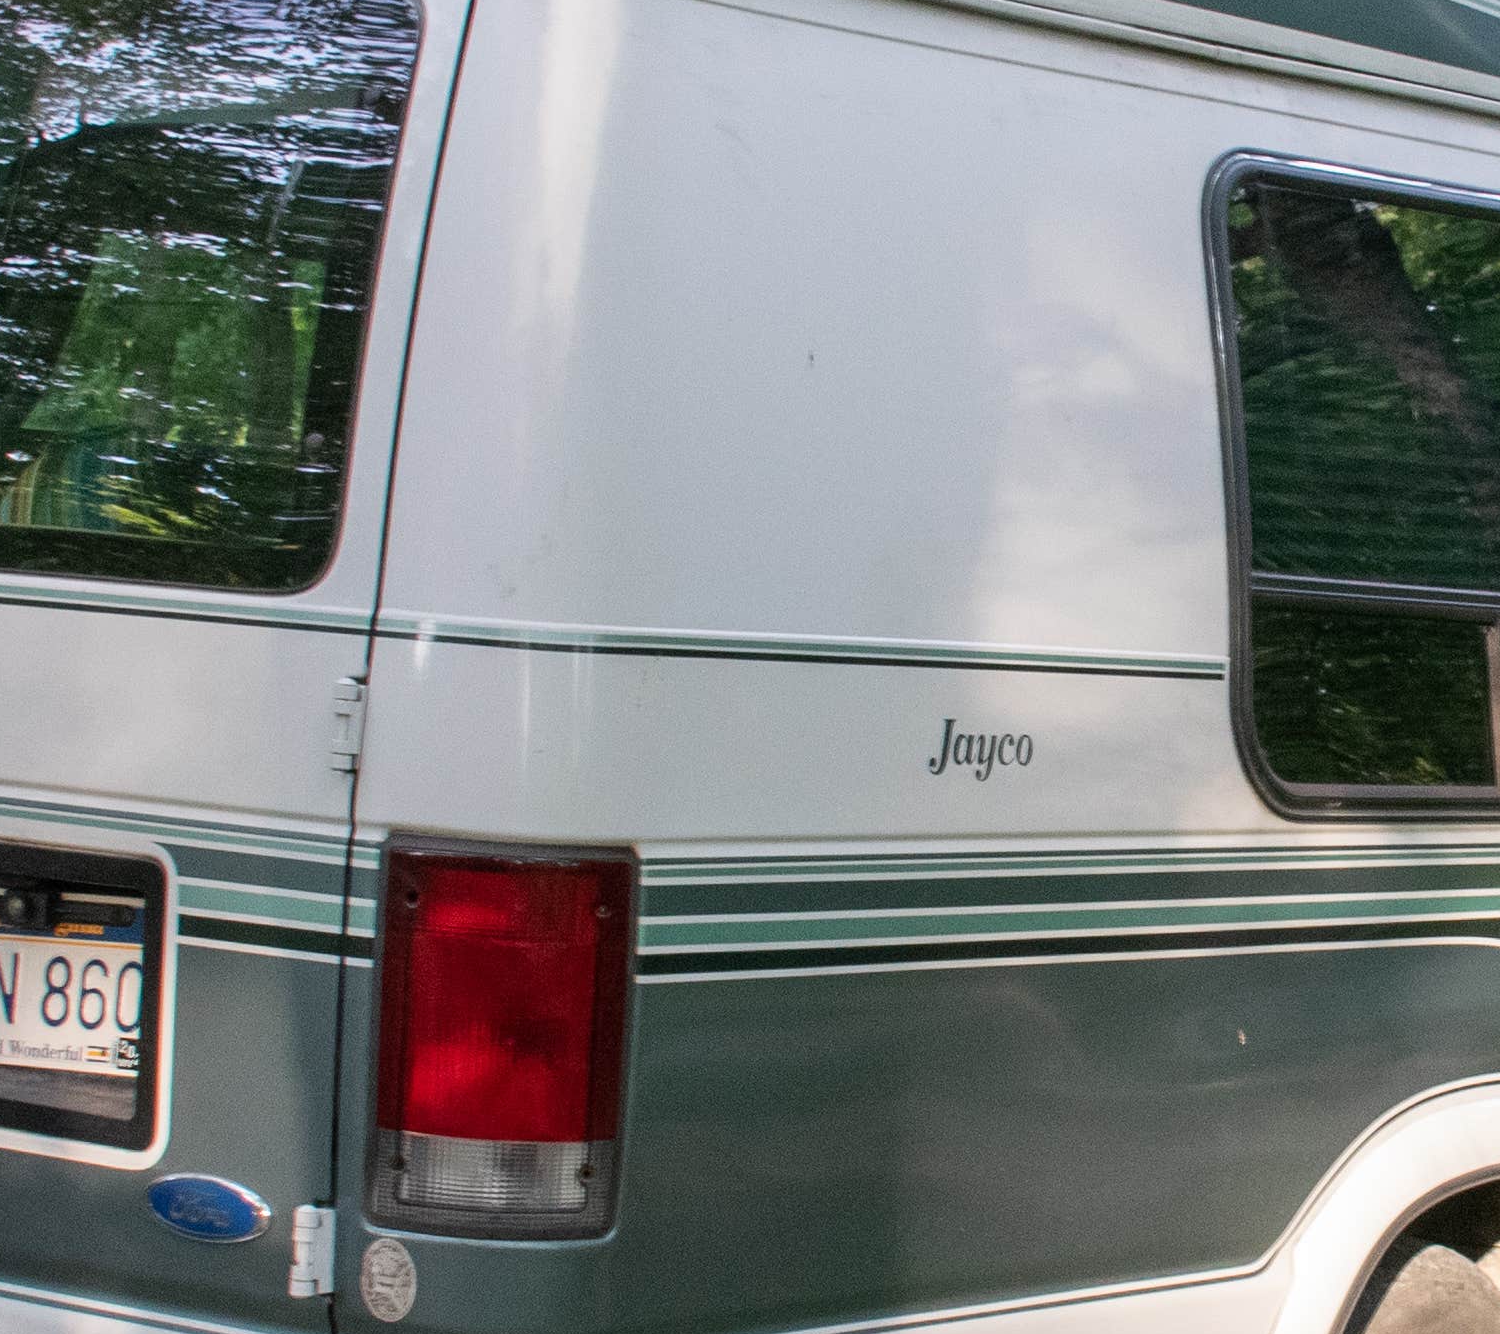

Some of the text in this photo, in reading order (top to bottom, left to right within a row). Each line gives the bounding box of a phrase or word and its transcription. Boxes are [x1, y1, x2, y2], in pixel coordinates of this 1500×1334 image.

[927, 717, 1034, 782] Jayco
[41, 955, 143, 1034] 860
[8, 1039, 83, 1062] Wonderful
